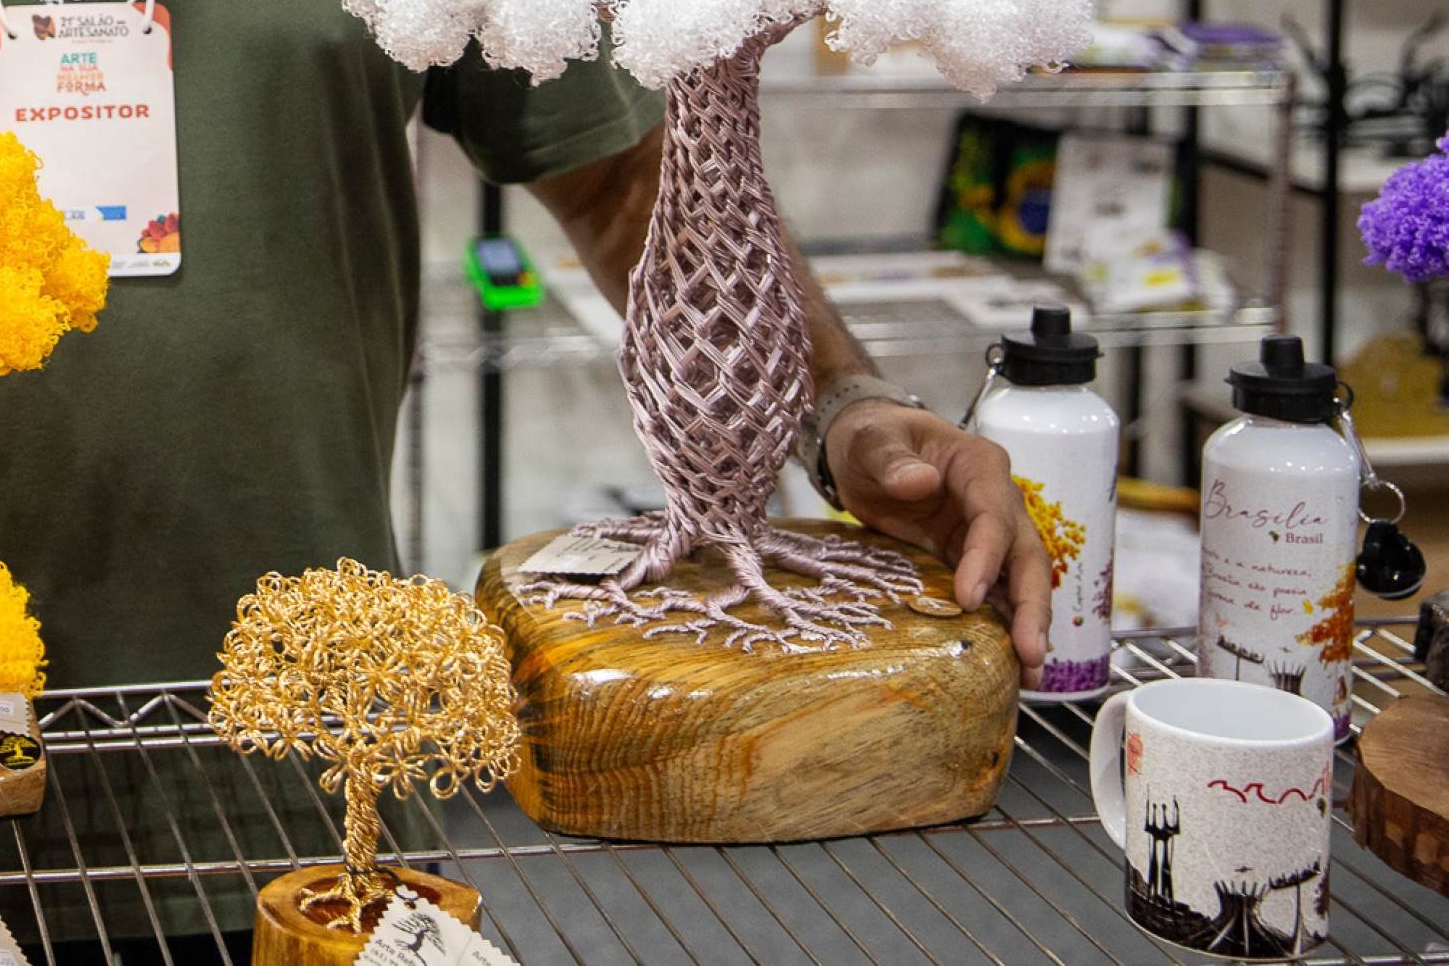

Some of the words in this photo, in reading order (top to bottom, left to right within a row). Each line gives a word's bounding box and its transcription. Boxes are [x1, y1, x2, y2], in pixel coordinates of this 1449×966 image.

[58, 25, 130, 38] ARTESANATO
[61, 52, 97, 64] ARTE
[57, 81, 106, 95] FORMA
[15, 104, 150, 122] EXPOSITOR
[1285, 532, 1324, 544] Brasil
[375, 938, 396, 955] Arte
